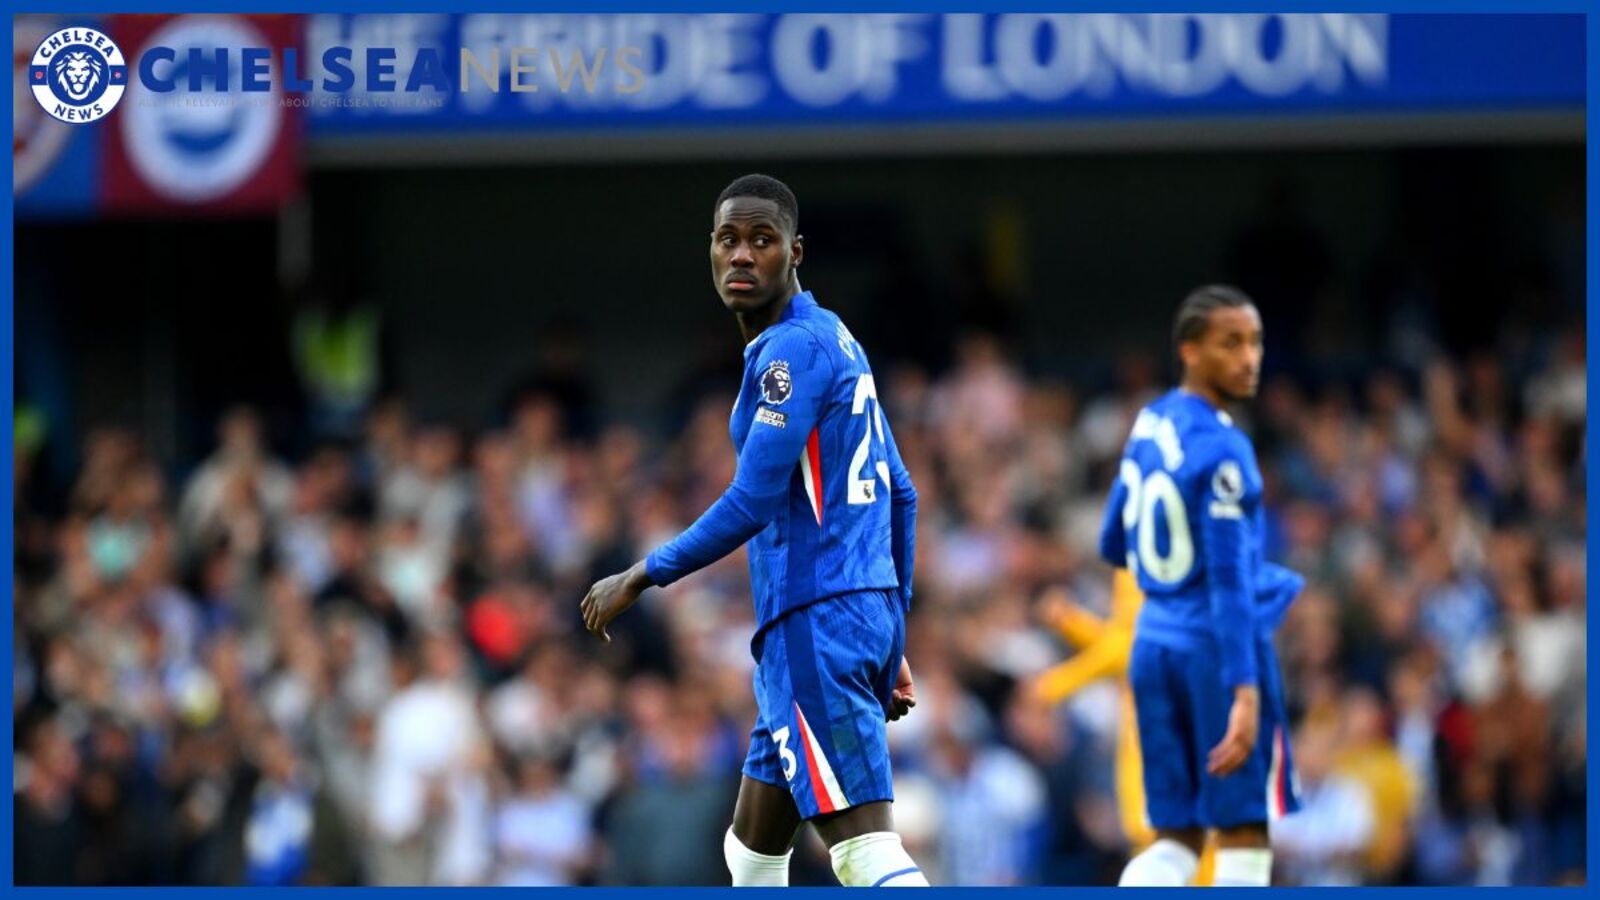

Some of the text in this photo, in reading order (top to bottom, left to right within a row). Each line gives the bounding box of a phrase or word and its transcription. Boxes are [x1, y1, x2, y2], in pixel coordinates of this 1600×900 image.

[771, 13, 926, 107] OF
[942, 13, 1390, 100] LONDON
[772, 725, 797, 781] 3
